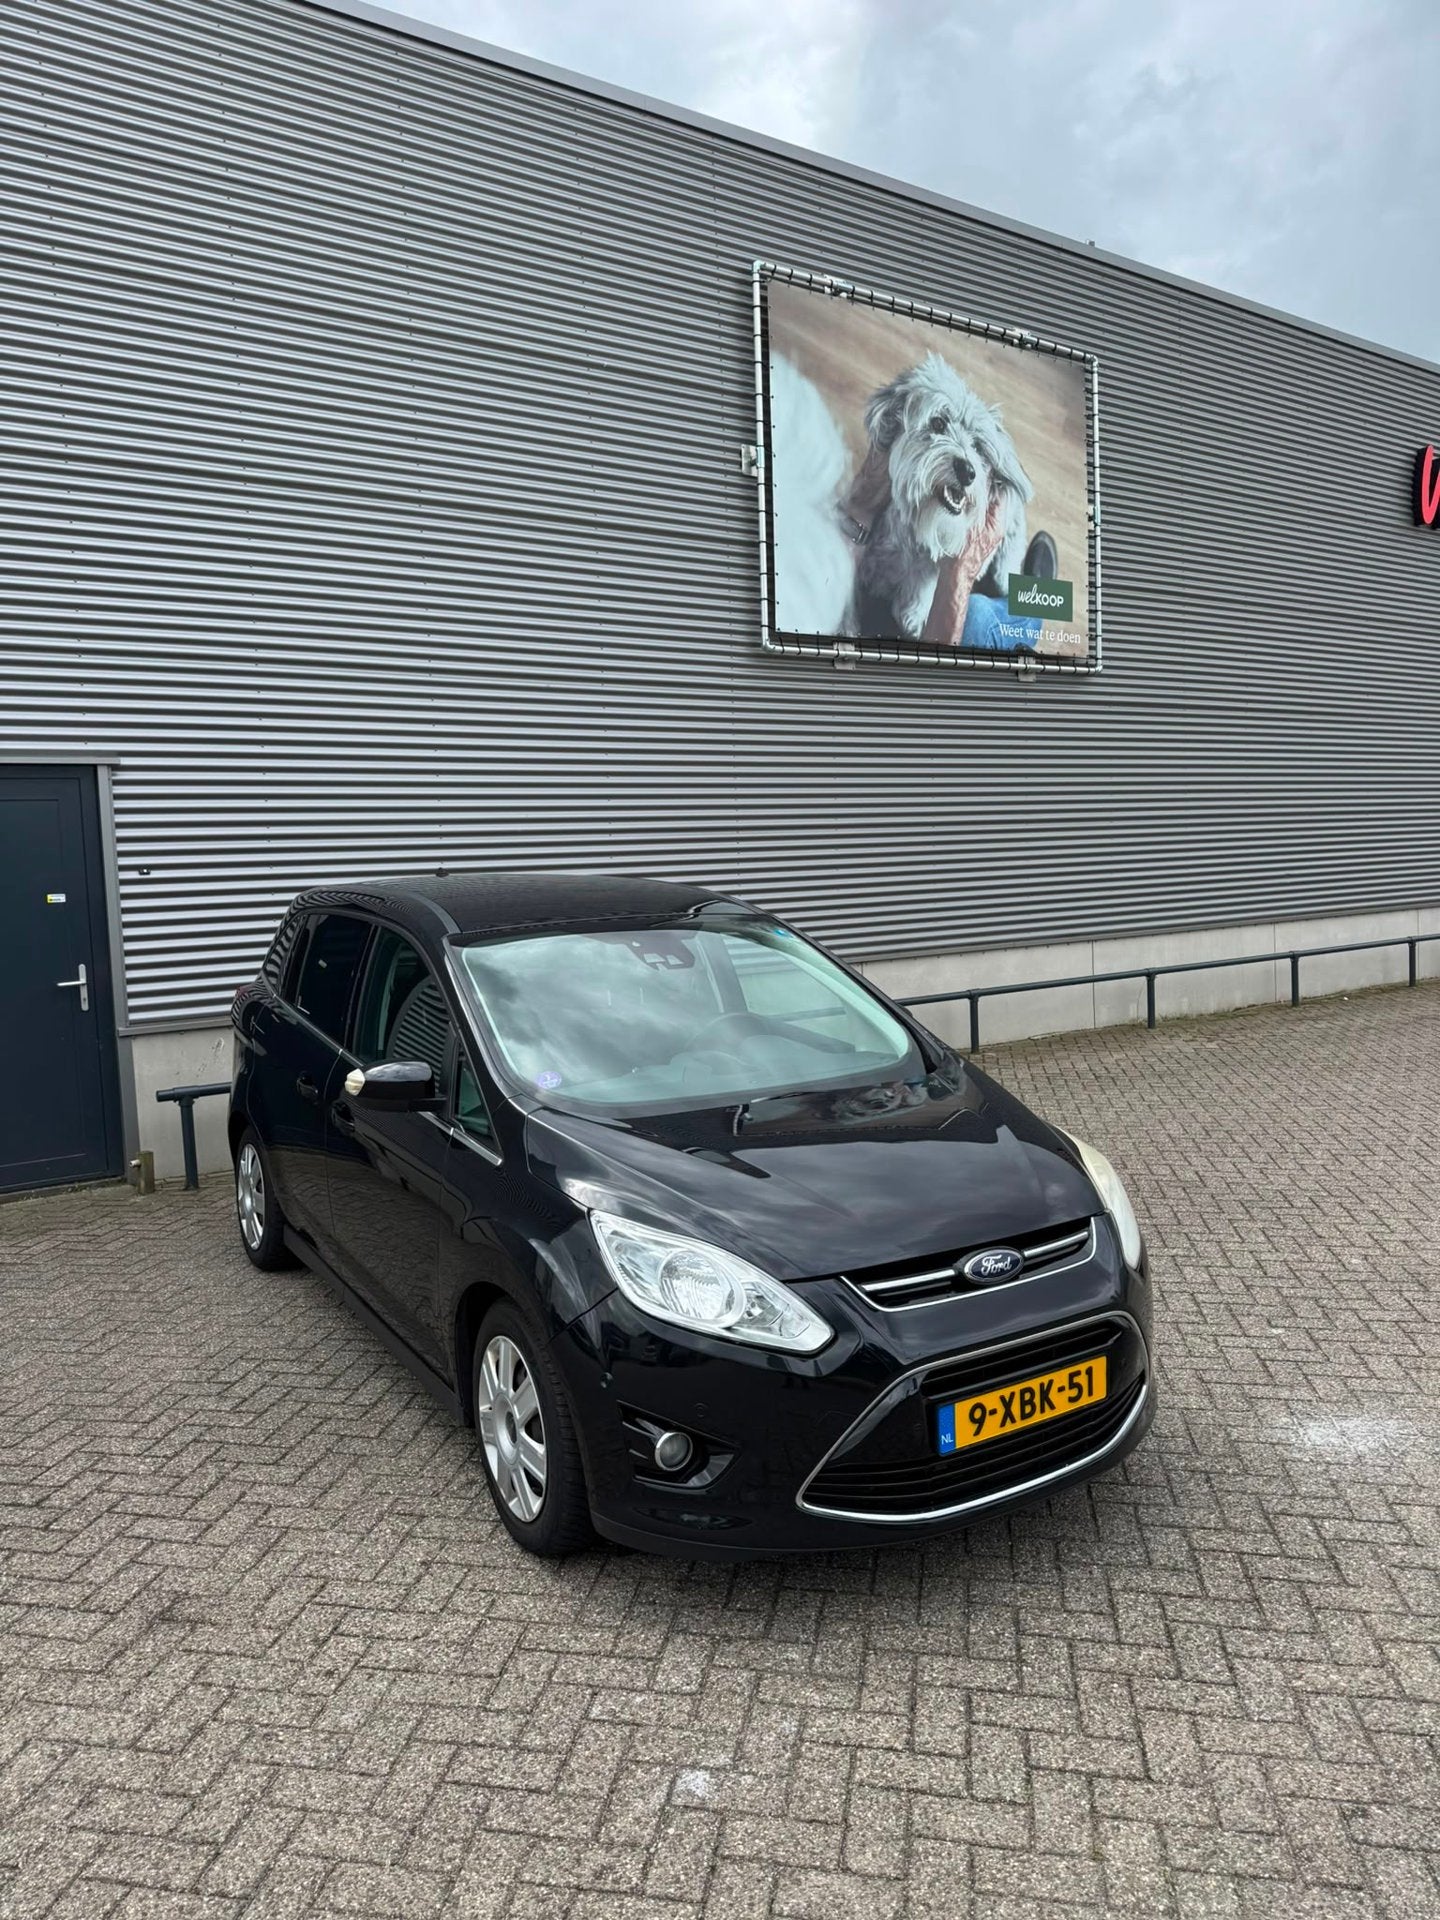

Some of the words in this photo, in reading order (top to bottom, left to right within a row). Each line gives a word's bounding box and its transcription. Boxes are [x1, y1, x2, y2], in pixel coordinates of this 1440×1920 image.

[1000, 623, 1024, 638] Weet
[1026, 628, 1043, 640] wat
[1046, 629, 1055, 641] te
[1057, 630, 1081, 644] doen
[980, 1254, 1013, 1276] Ford
[968, 1366, 1094, 1437] 9-XBK-51
[941, 1433, 954, 1445] NL
